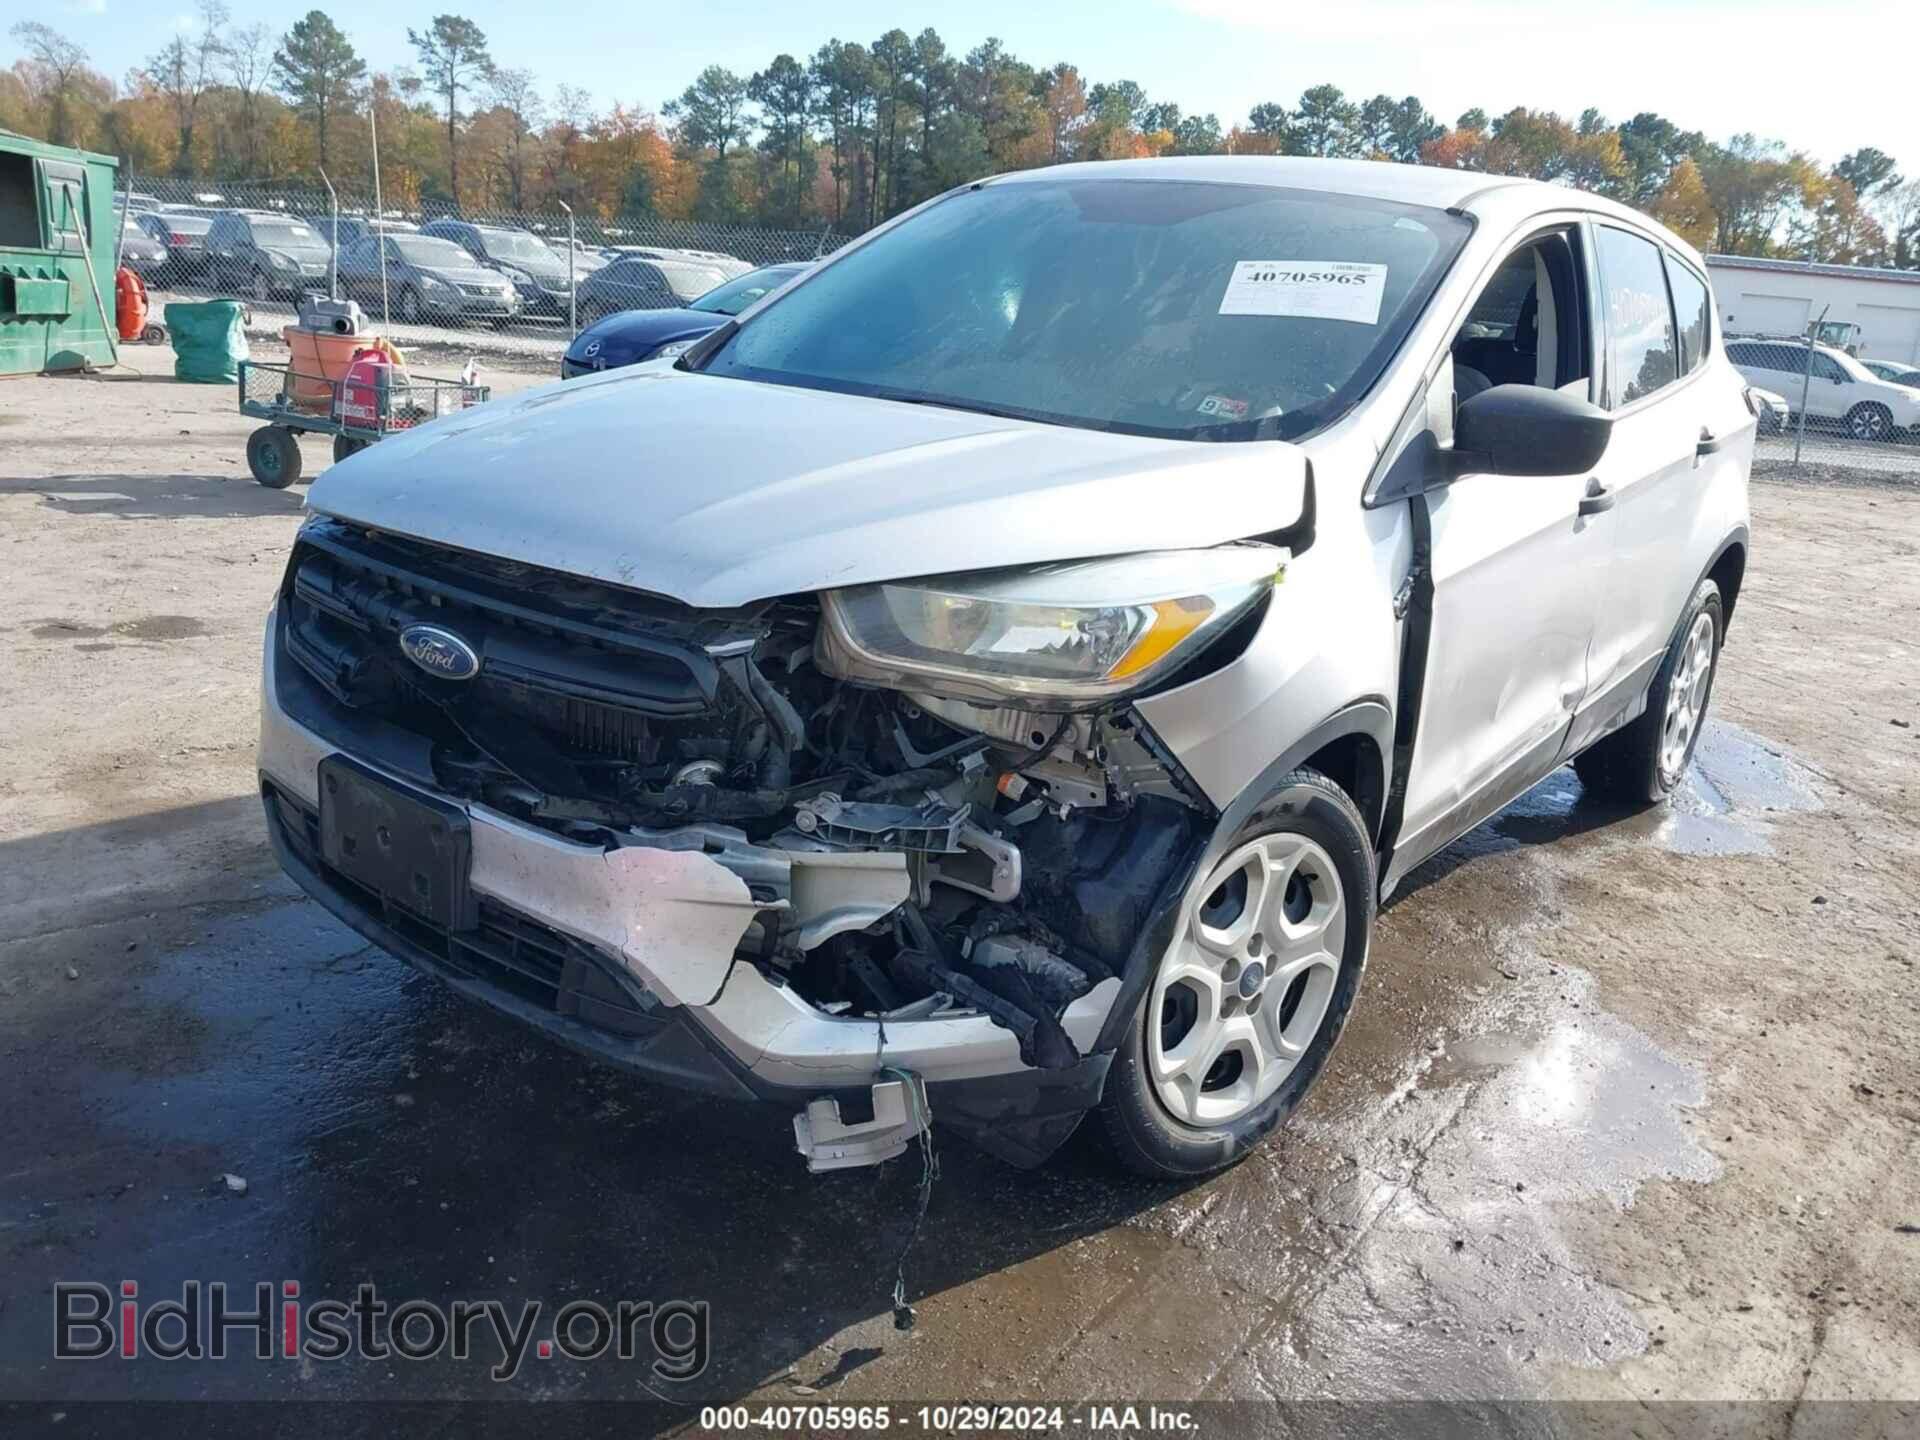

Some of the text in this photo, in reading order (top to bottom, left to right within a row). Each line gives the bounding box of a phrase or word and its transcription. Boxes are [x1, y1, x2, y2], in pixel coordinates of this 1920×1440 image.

[1247, 271, 1367, 285] 40705965
[1204, 400, 1216, 411] 9
[415, 637, 456, 670] Ford
